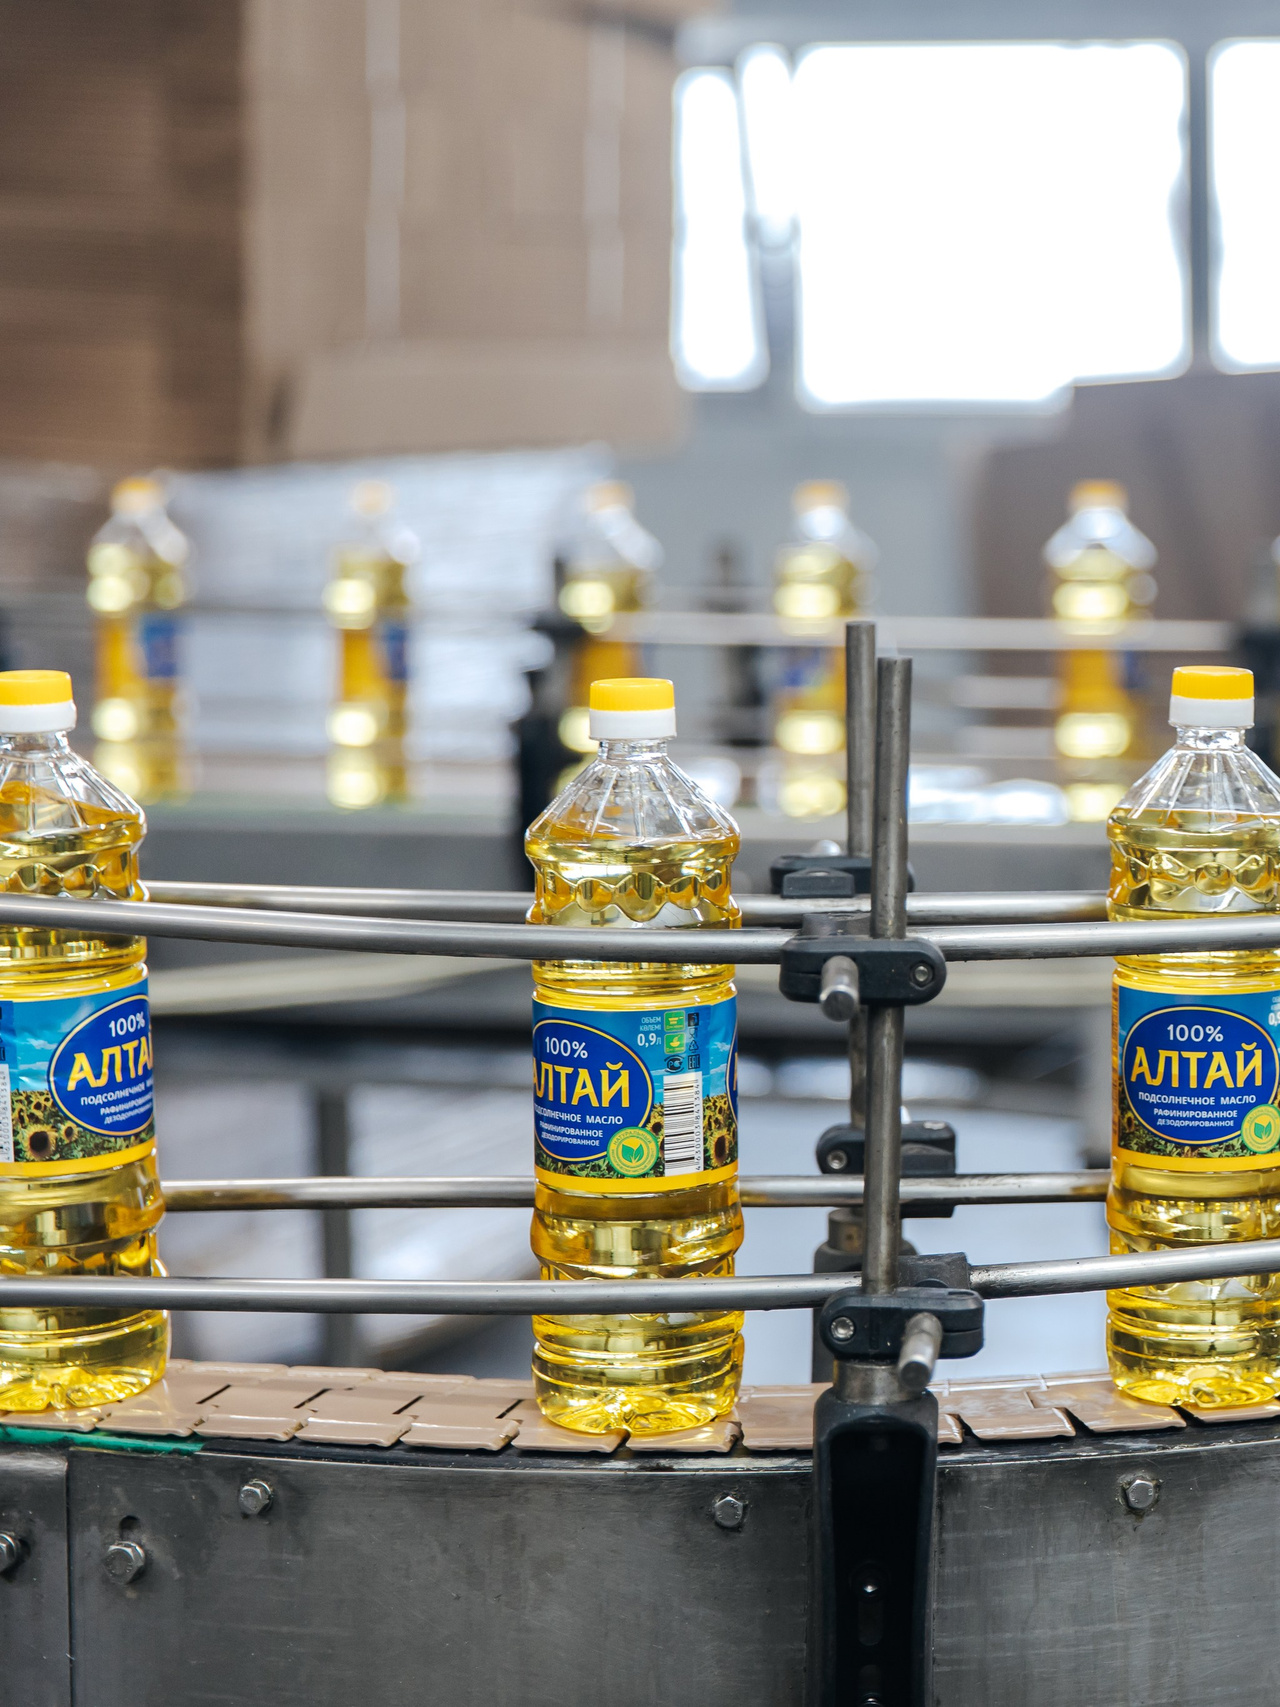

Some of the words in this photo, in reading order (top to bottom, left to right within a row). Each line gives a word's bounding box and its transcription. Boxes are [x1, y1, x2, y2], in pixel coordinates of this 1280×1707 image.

[109, 1012, 146, 1037] 100%
[1166, 1024, 1224, 1042] 100%
[544, 1036, 589, 1059] 100%
[1130, 1042, 1263, 1089] АЛТАЙ
[1138, 1091, 1215, 1105] ПОДСОЛНЕЧНОЕ
[1220, 1095, 1257, 1105] МАСЛО
[586, 1115, 624, 1125] МАСЛО
[1153, 1107, 1238, 1118] РАФИНИРОВАННОЕ
[1156, 1118, 1235, 1128] ДЕЗОДОРИРОВАННОЕ
